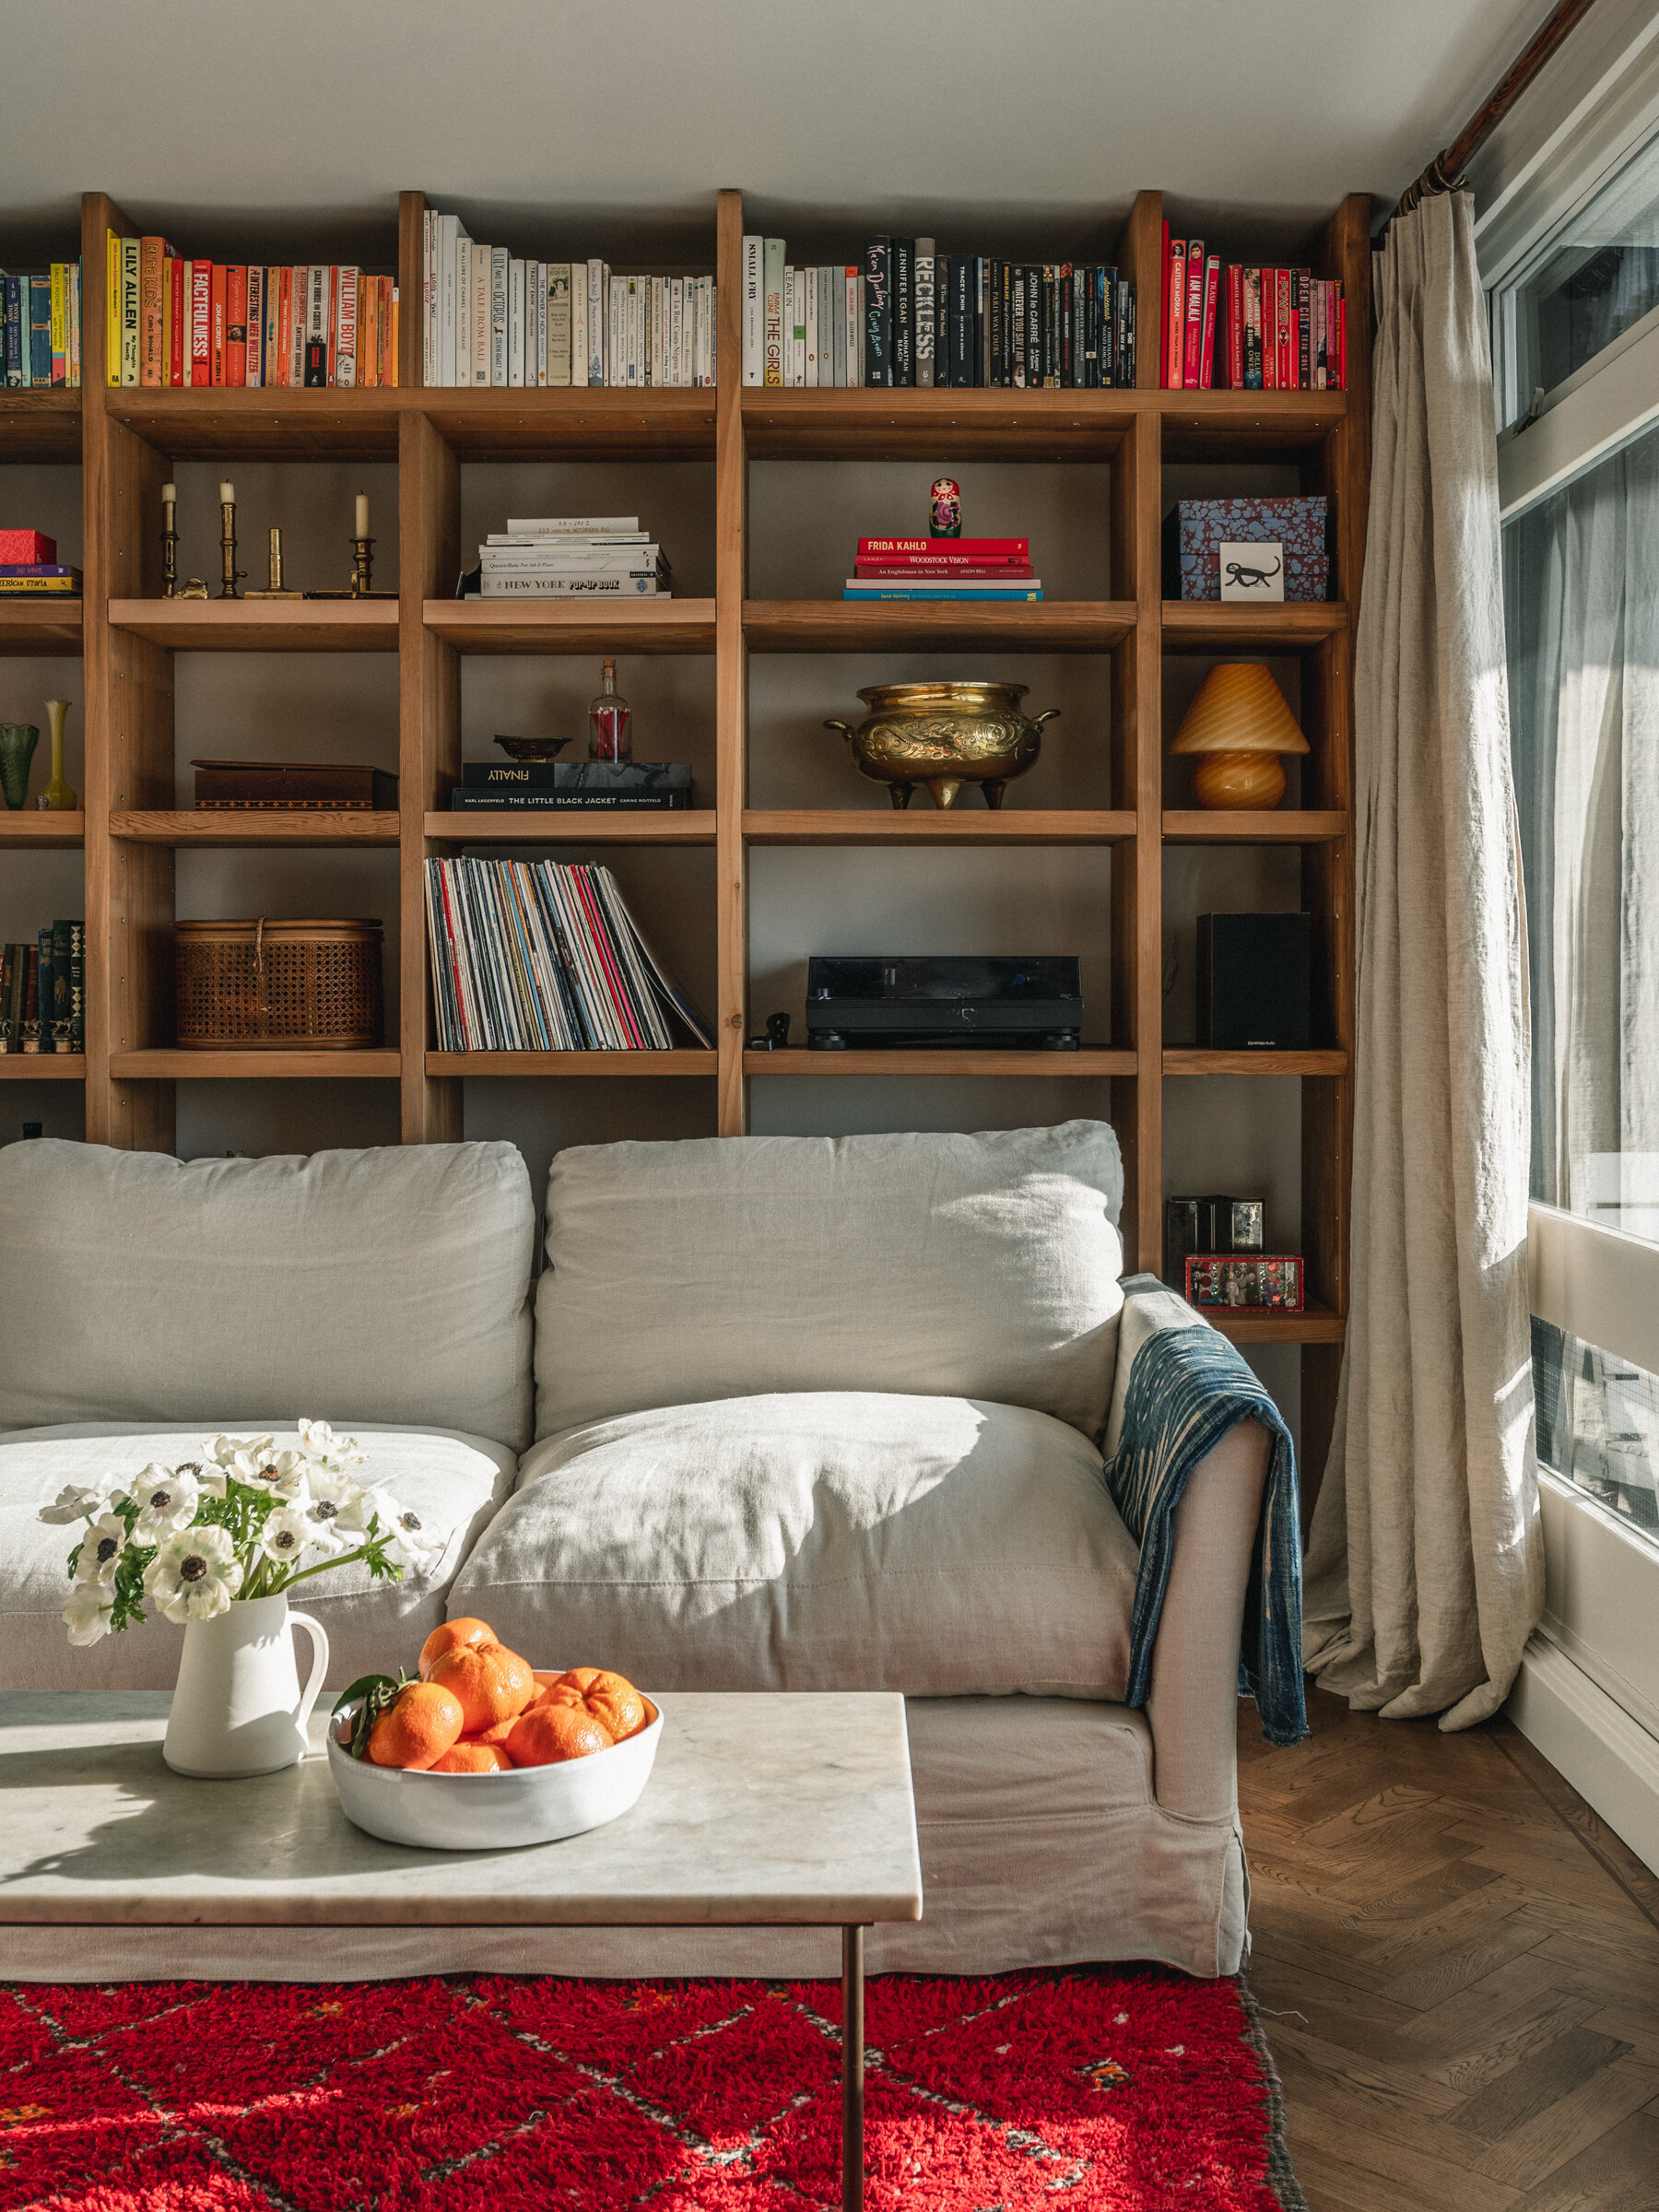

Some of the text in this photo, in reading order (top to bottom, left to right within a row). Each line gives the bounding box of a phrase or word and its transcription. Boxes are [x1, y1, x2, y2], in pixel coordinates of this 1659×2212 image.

[146, 244, 159, 275] RUDE
[493, 253, 504, 269] LILY
[125, 246, 136, 329] LILY ALLEN
[145, 277, 158, 308] KIDS
[313, 287, 322, 302] HORSE
[1015, 280, 1024, 316] WHATEVER
[1030, 272, 1038, 298] JOHN
[1189, 279, 1201, 291] AM
[1208, 280, 1217, 304] TRASH
[1300, 276, 1309, 302] OPEN
[493, 291, 505, 323] OCTOPUS
[674, 300, 680, 309] La
[785, 298, 793, 306] IN
[866, 245, 888, 357] Ma'am Darling Craig Brown
[915, 257, 935, 359] RECKLESS
[1103, 276, 1112, 321] Americanah
[1188, 293, 1200, 322] MALALA
[1279, 280, 1288, 325] POWER
[193, 274, 208, 357] FACTFULNESS
[249, 276, 259, 373] INTERESTINGS MEG WOLITZER
[313, 312, 322, 330] CUSTER
[341, 269, 355, 355] WILLIAM BOYD
[1015, 318, 1024, 332] YOU
[1300, 307, 1309, 329] CITY
[1015, 333, 1024, 346] SAY
[1030, 311, 1040, 343] CARRÉ
[216, 350, 221, 360] MY
[767, 317, 781, 384] THE GIRLS
[1015, 350, 1024, 361] AM
[867, 541, 927, 550] FRIDA KAHLO
[505, 580, 620, 590] NEW YORK POP-UP BOOK
[488, 770, 529, 781] FINALLY
